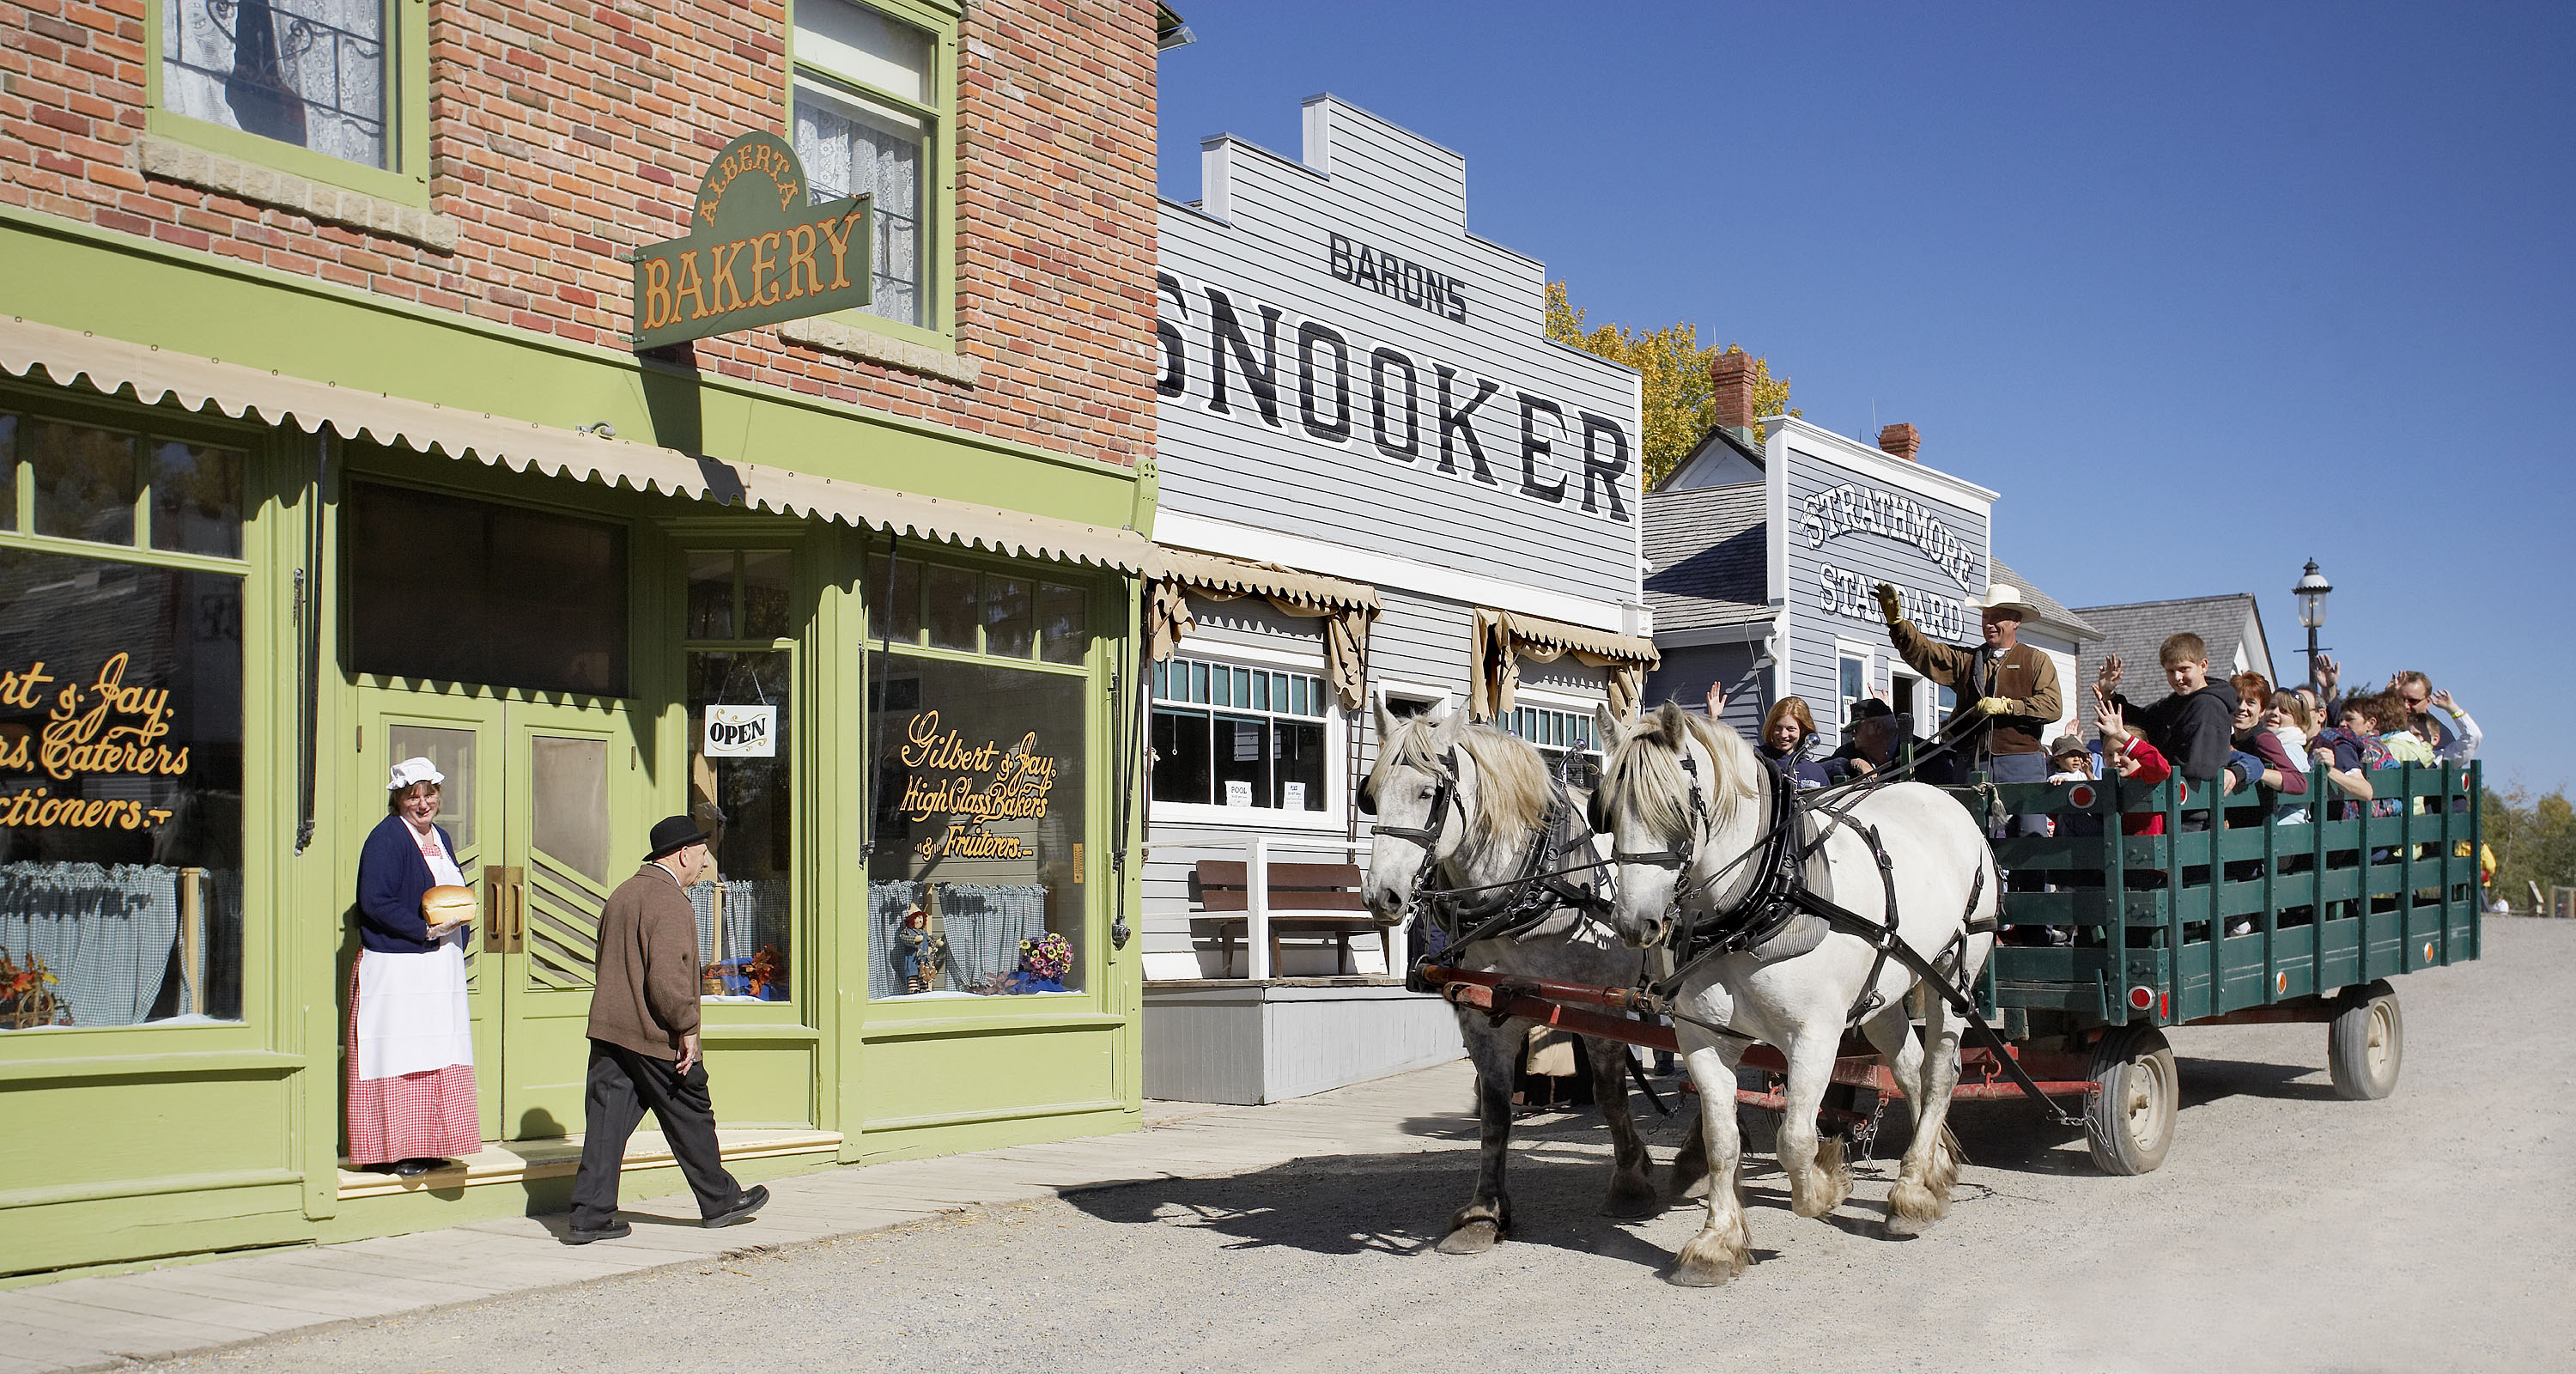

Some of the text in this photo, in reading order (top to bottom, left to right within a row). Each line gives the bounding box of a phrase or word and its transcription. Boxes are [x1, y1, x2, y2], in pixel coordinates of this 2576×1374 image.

[699, 143, 799, 228] ALBERTA
[643, 212, 862, 331] BAKERY
[1329, 231, 1467, 325] BARONS
[1797, 483, 1975, 593] STRATHMORE
[1819, 562, 1965, 641] STADARD
[40, 720, 190, 781] Caterers
[709, 717, 766, 745] OPEN
[901, 709, 1000, 773] Gilbert
[899, 775, 1048, 824] High Class Bakers
[1230, 786, 1248, 794] POOL
